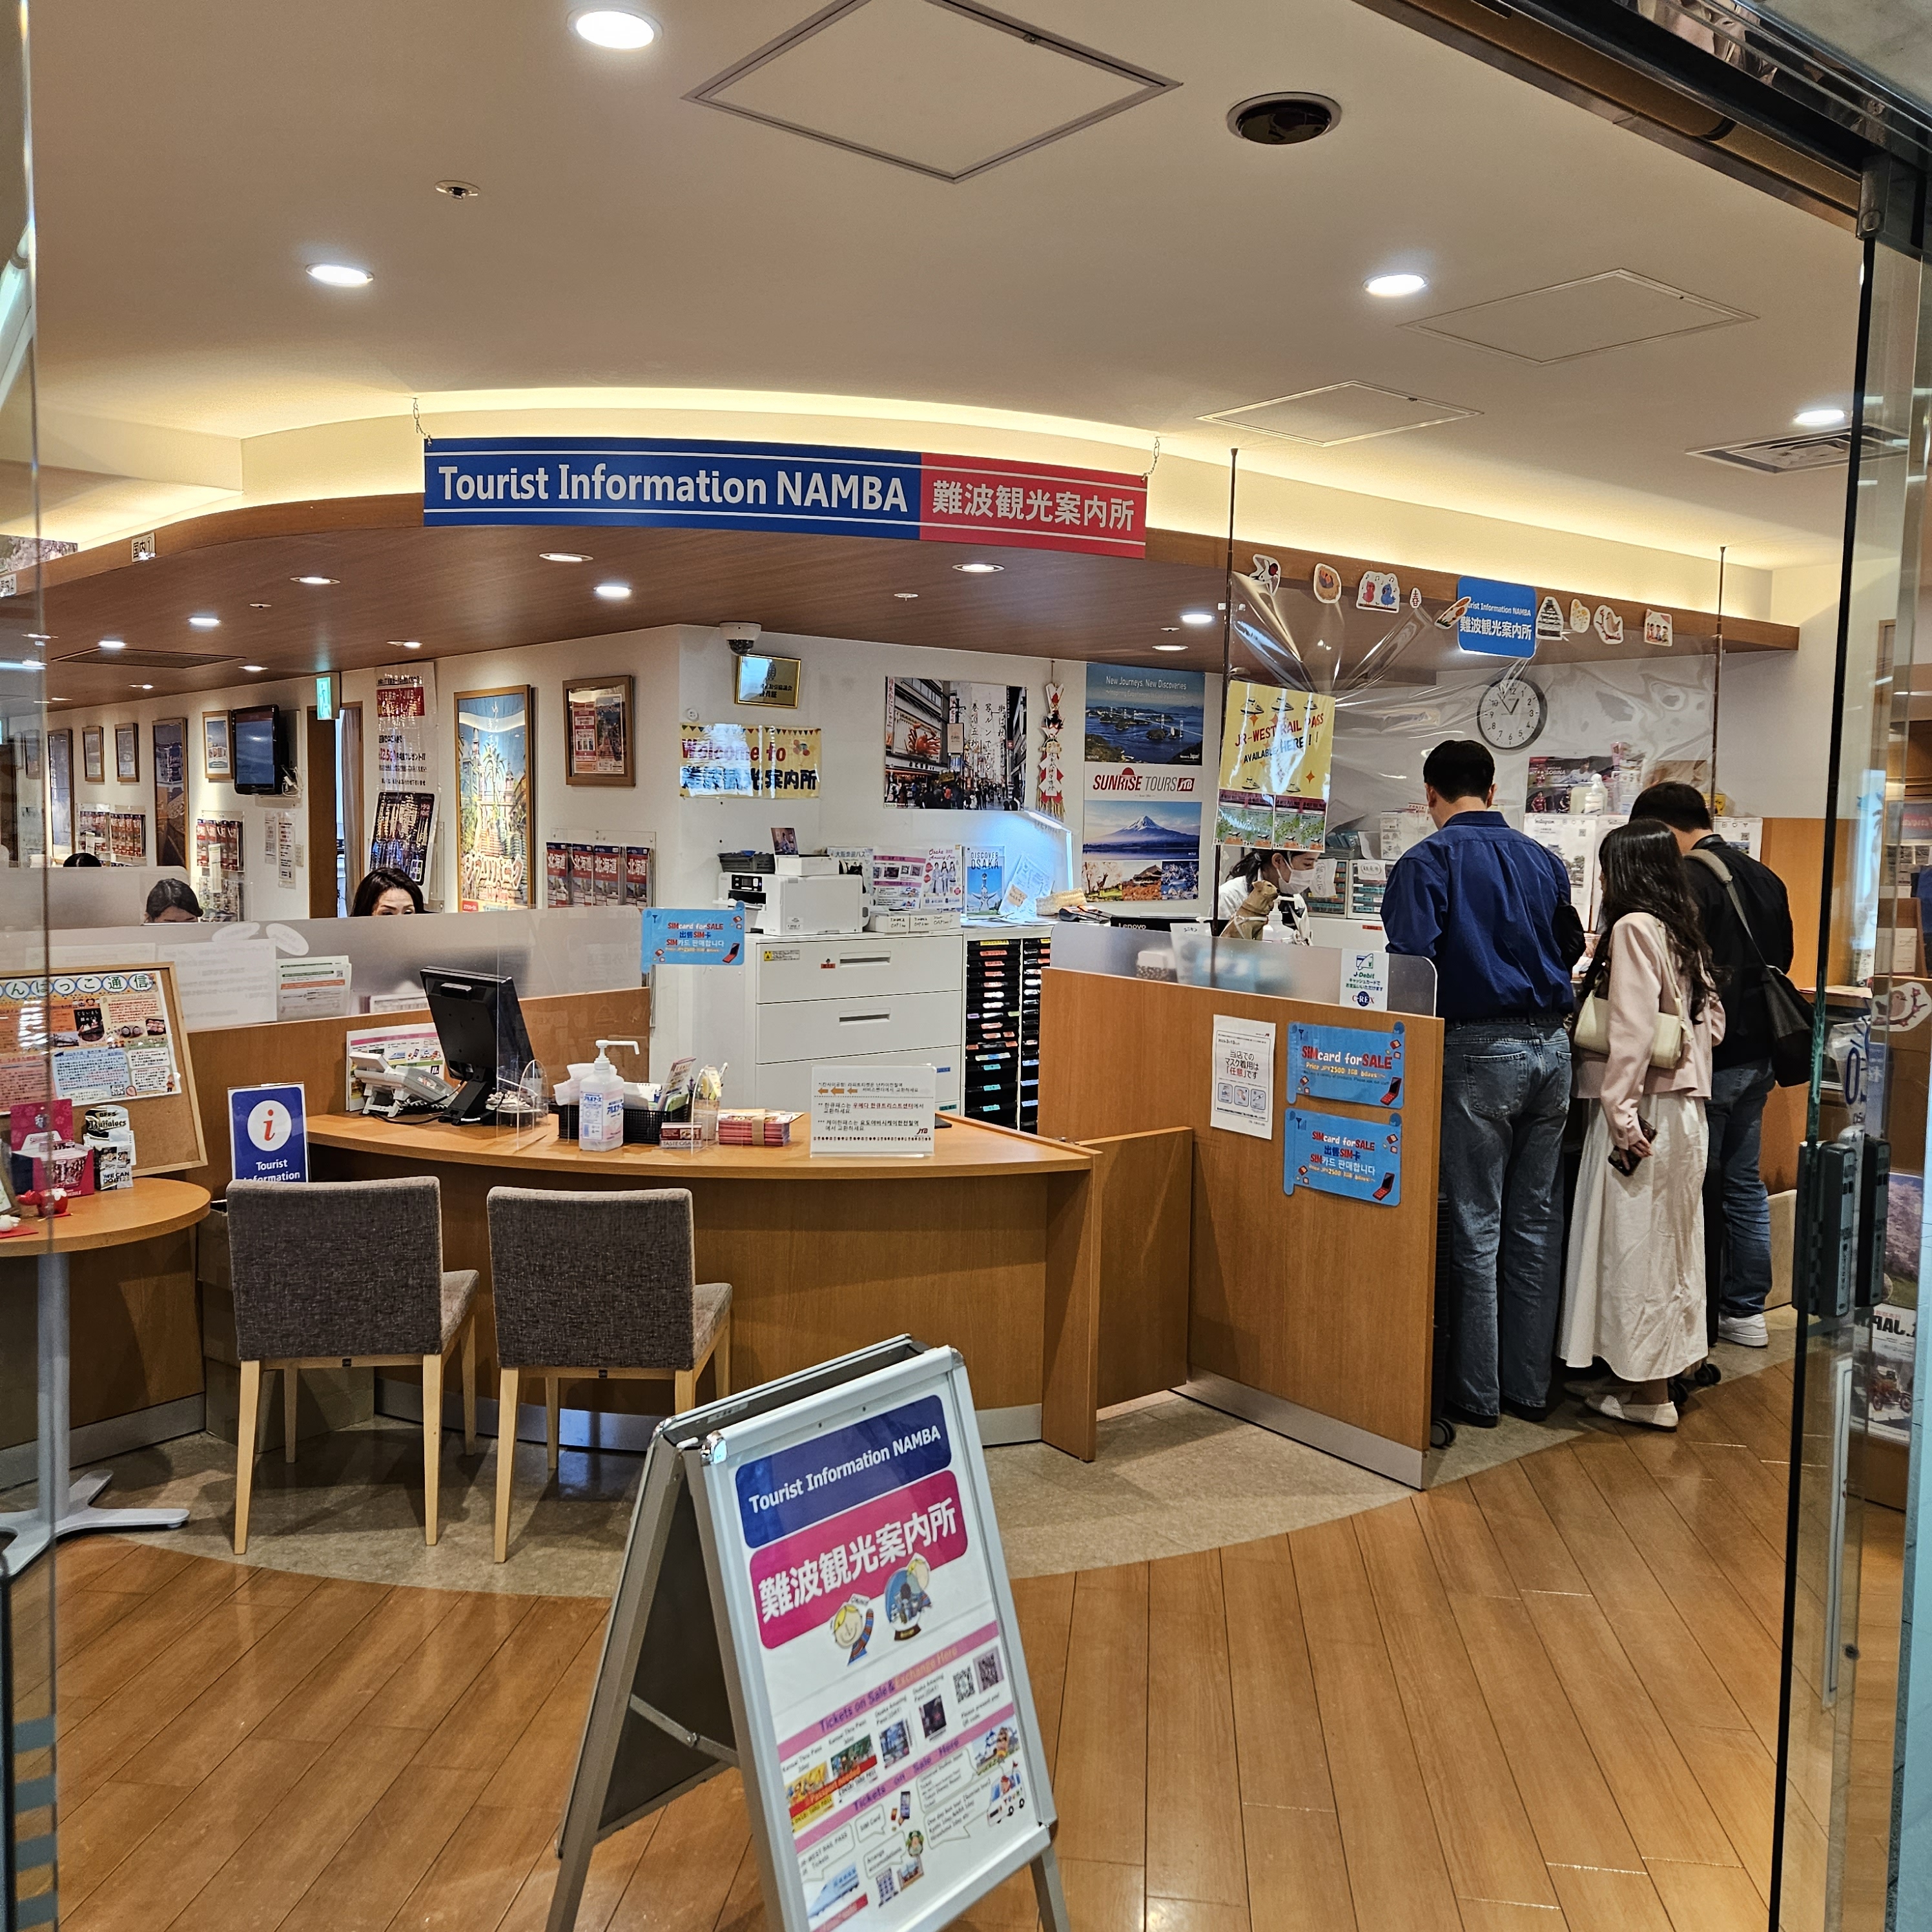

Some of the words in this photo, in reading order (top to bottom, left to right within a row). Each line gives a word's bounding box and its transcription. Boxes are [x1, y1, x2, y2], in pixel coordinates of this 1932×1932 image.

[438, 463, 549, 502] Tourist
[558, 463, 766, 506] Information
[777, 470, 908, 513] NAMBA
[932, 480, 1135, 531] 難波観光案内所
[1481, 603, 1512, 613] Information
[1512, 607, 1532, 617] NAMBA
[1459, 615, 1532, 640] 難波観光案内所
[1106, 676, 1118, 684] New
[1146, 679, 1156, 688] New
[1158, 679, 1187, 690] Discoveries
[1235, 726, 1277, 747] JR-WEST
[1280, 720, 1302, 735] RAIL
[682, 739, 759, 761] Welcome
[766, 741, 786, 761] to
[1093, 774, 1143, 791] SUNRISE
[1146, 776, 1177, 792] TOURS
[1177, 778, 1195, 792] JTB
[548, 853, 566, 869] 北海道
[574, 855, 593, 871] 北海道
[595, 857, 617, 874] 北海道
[628, 859, 647, 876] 北海道
[971, 859, 1000, 870] OSAKA
[1349, 978, 1381, 986] キャッシュカードで
[1352, 994, 1375, 1004] C-REX
[1229, 1049, 1255, 1061] 当店での
[1302, 1045, 1341, 1063] SIMcard
[1344, 1053, 1393, 1070] forSALE
[1225, 1058, 1259, 1071] マスク着用は
[1226, 1066, 1259, 1080] 「任意」です
[1306, 1062, 1320, 1070] Price
[88, 1118, 127, 1130] Buffaloes
[1312, 1131, 1340, 1144] SIMcard
[1342, 1138, 1375, 1151] forSALE
[256, 1158, 288, 1171] Tourist
[1310, 1153, 1336, 1167] SIM카드
[1338, 1158, 1375, 1176] 판매합니다
[243, 1171, 300, 1182] formation
[748, 1478, 804, 1514] Tourist
[805, 1446, 890, 1490] Information
[892, 1424, 941, 1457] NAMBA
[758, 1497, 957, 1625] 難波観光案内所
[819, 1703, 853, 1732] Tickets
[854, 1697, 867, 1711] on
[852, 1784, 886, 1811] Tickets
[893, 1771, 906, 1786] on
